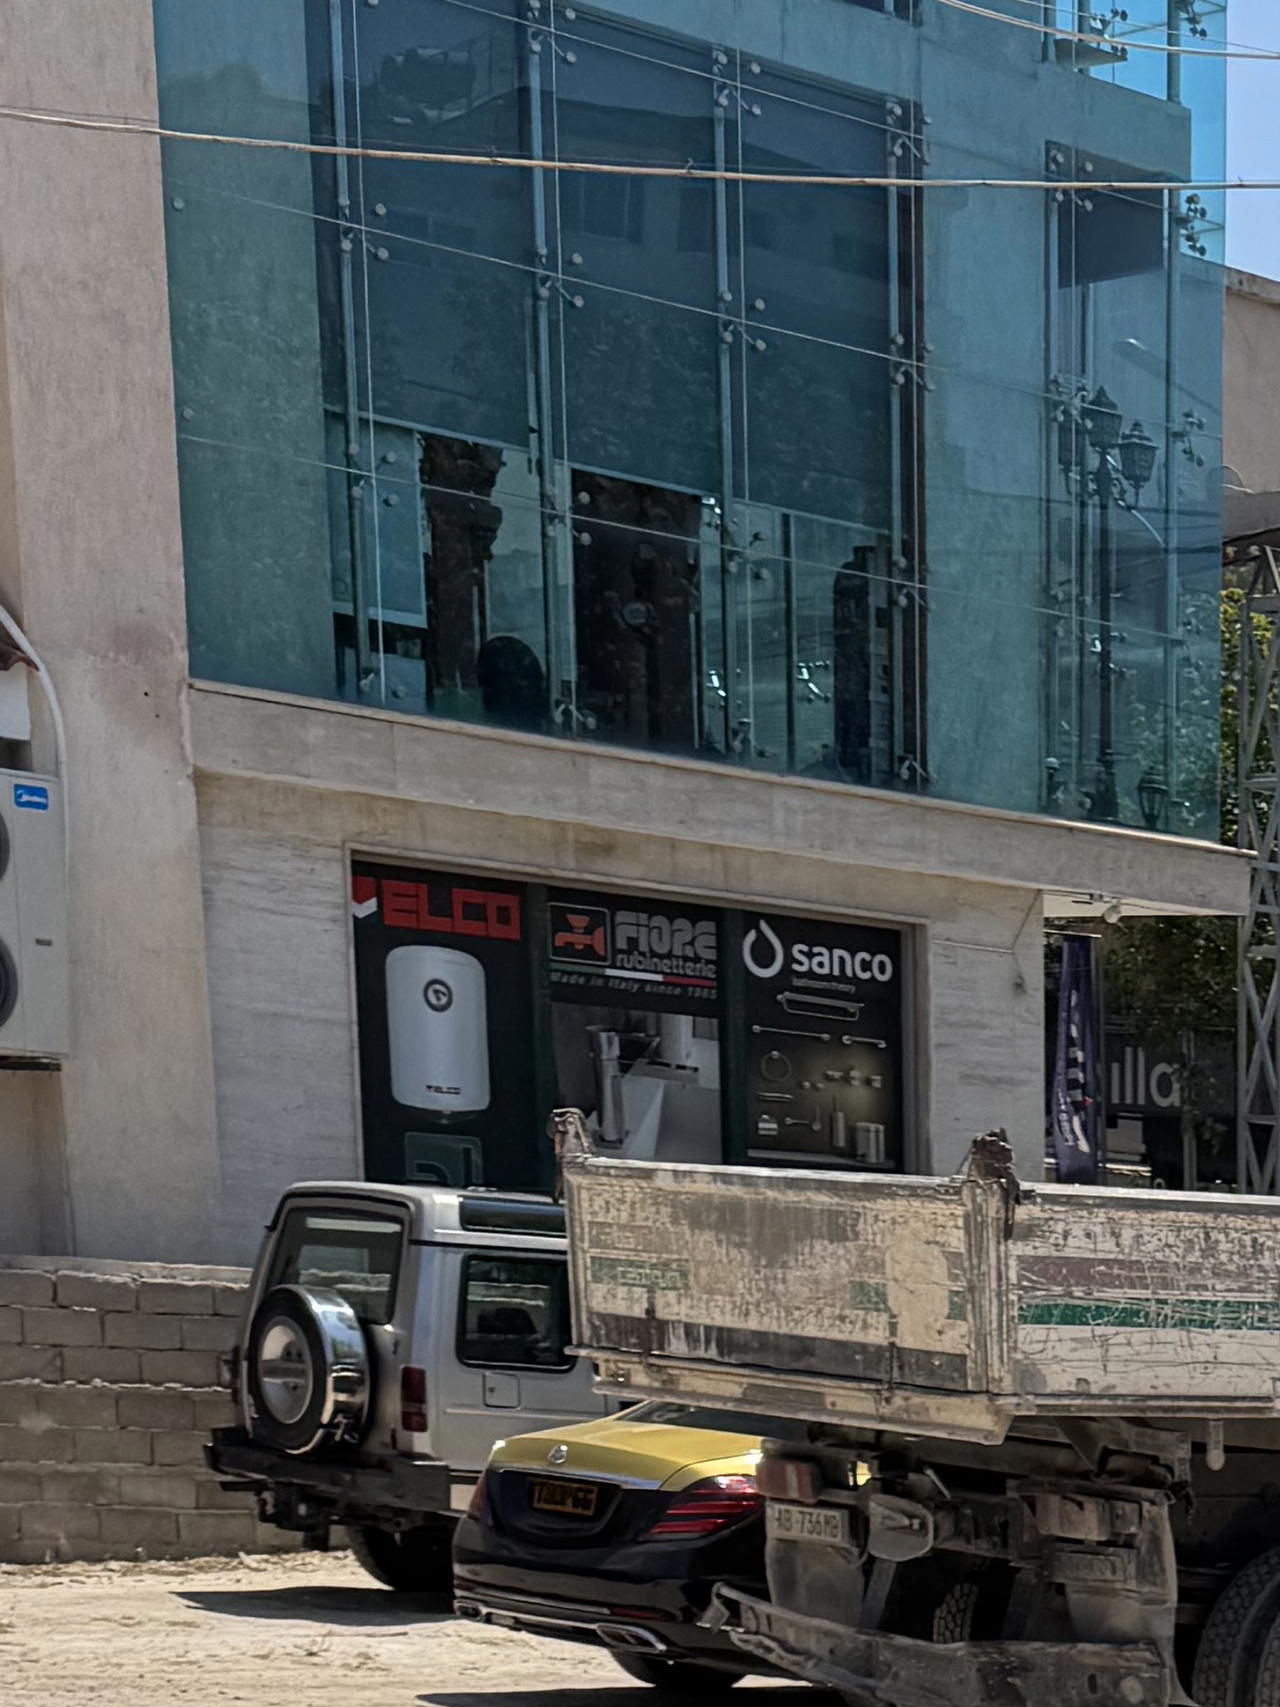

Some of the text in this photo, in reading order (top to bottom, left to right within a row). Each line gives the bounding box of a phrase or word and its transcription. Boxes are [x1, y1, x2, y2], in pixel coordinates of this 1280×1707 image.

[382, 880, 521, 940] ELCO
[616, 950, 717, 979] rubinetterie
[791, 943, 893, 982] sanco
[549, 971, 586, 986] Made
[590, 974, 605, 987] in
[608, 976, 642, 993] Italy
[645, 983, 681, 995] since
